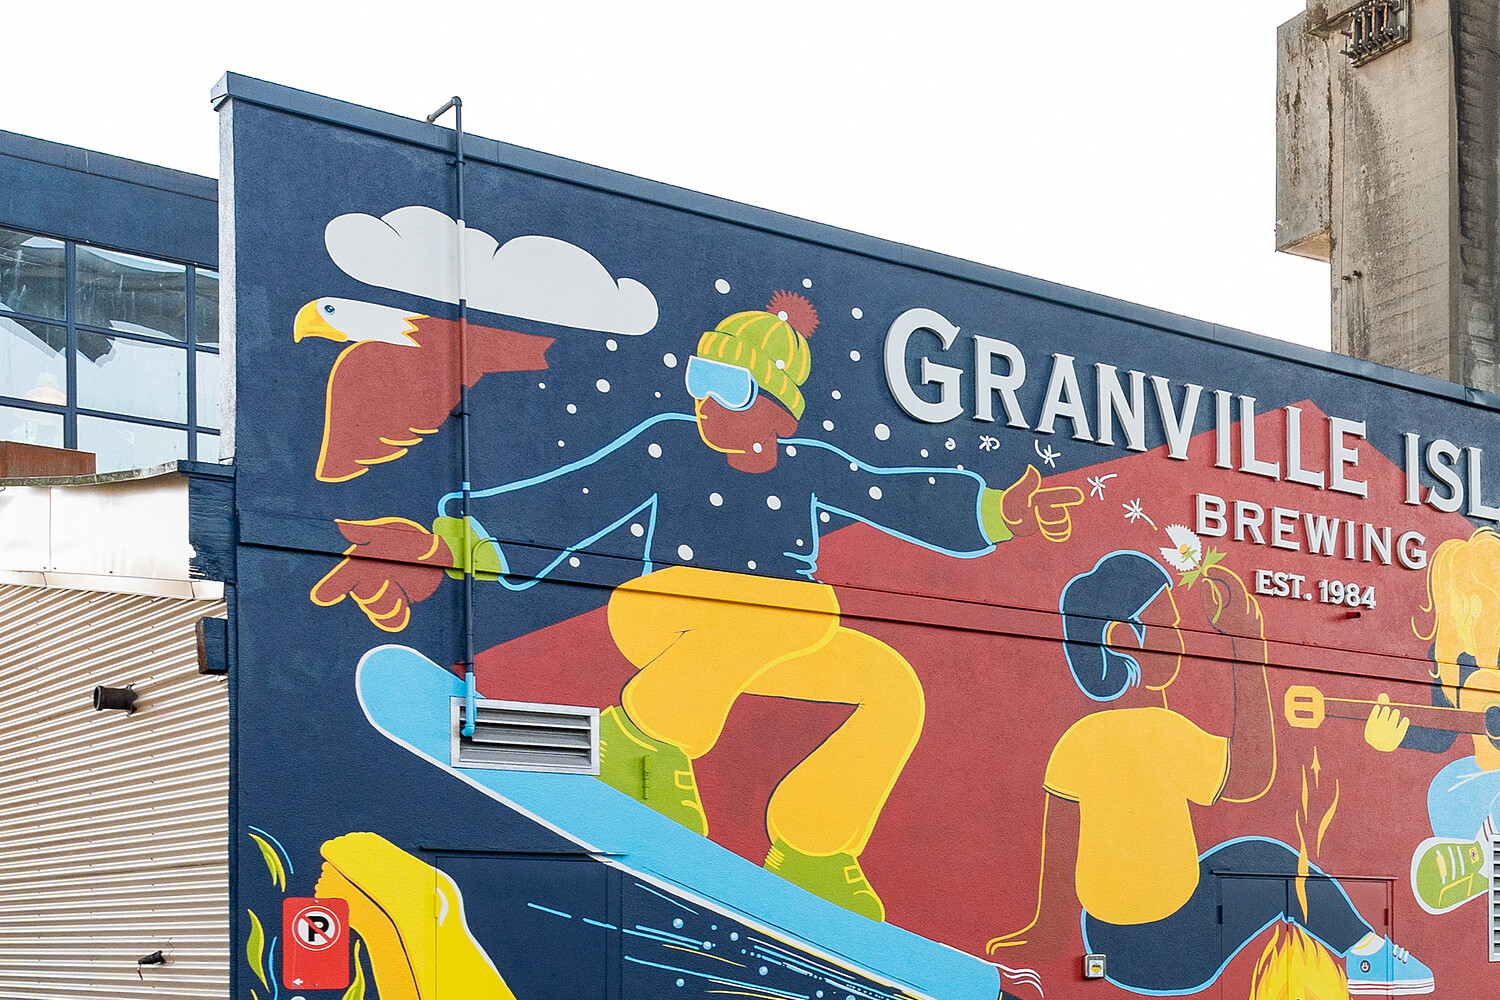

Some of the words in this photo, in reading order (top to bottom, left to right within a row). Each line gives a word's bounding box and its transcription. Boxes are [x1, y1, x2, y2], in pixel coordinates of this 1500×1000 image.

[883, 307, 1368, 498] GRANVILLE
[1195, 493, 1429, 570] BREWING
[1255, 569, 1312, 601] EST.
[1319, 579, 1377, 611] 1984
